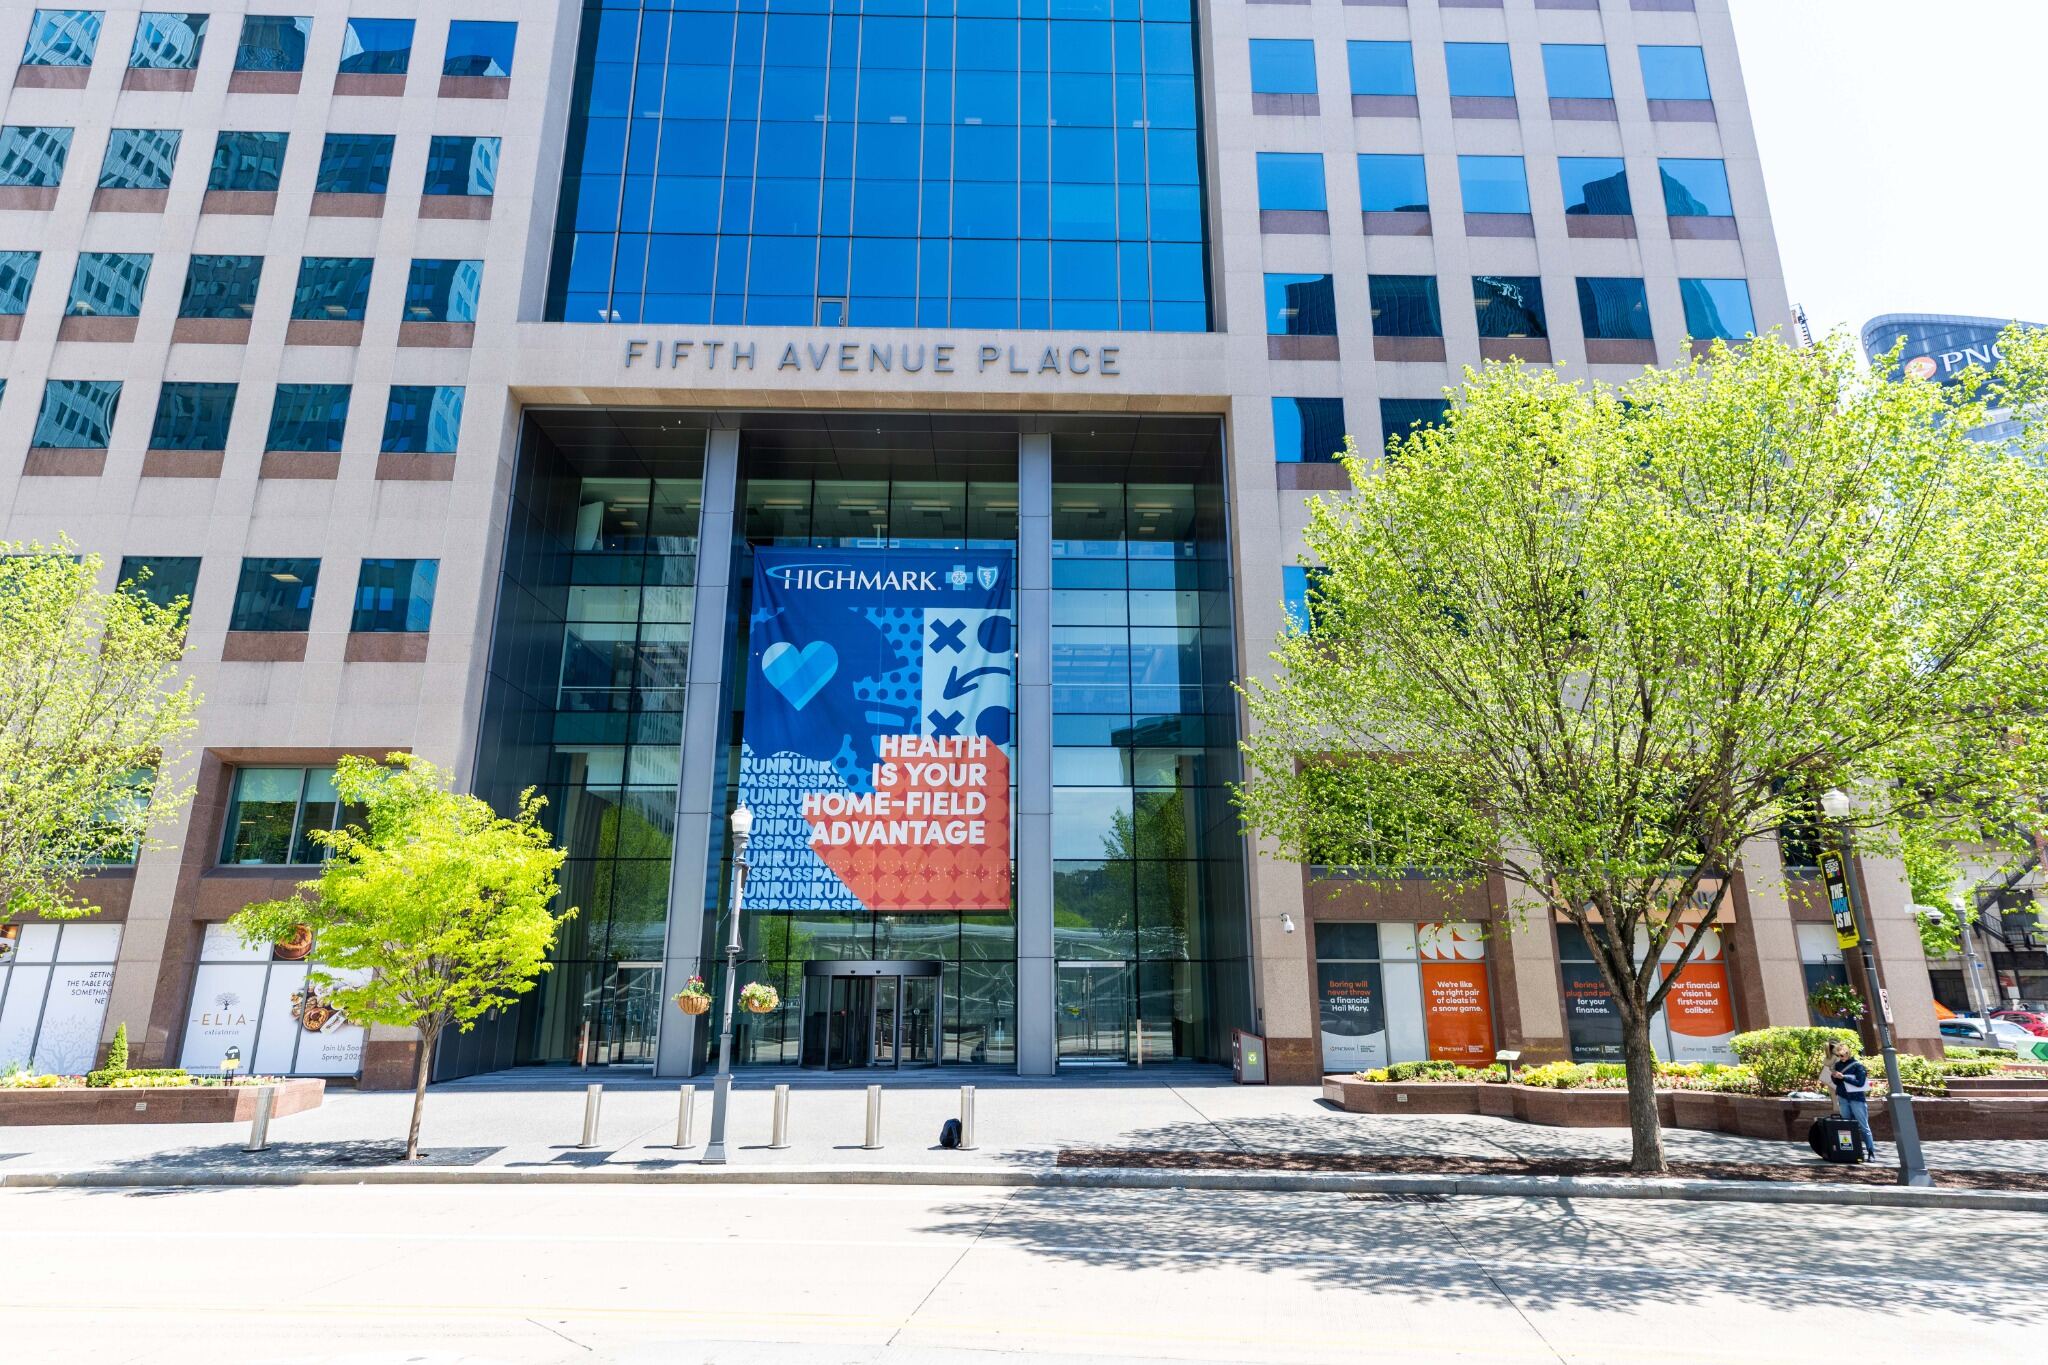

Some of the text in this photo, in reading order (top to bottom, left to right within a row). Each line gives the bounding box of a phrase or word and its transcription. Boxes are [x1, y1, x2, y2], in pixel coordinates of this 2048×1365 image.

[624, 338, 1121, 376] FIFTH AVENUE PLACE
[1938, 341, 2006, 372] PNC
[784, 569, 937, 591] HIGHMARK
[879, 734, 987, 758] HEALTH
[871, 762, 987, 787] IS YOUR
[801, 791, 987, 817] HOME-FIELD
[807, 820, 986, 845] ADVANTAGE
[1829, 883, 1844, 899] THE
[1329, 980, 1368, 989] Boring will
[1573, 981, 1598, 990] Boring
[1686, 981, 1720, 989] financial
[1446, 989, 1464, 998] right
[1465, 989, 1480, 997] pair
[1566, 990, 1582, 998] plug
[1599, 990, 1611, 998] pla
[1337, 996, 1370, 1004] financial
[1437, 996, 1477, 1004] of cleats in
[1589, 999, 1606, 1007] your
[1677, 998, 1719, 1006] first-round
[1348, 1005, 1369, 1013] Mary.
[1575, 1006, 1610, 1014] finances.
[1684, 1006, 1715, 1014] caliber.
[201, 1013, 247, 1026] ELIA
[322, 1044, 336, 1052] Join
[347, 1044, 361, 1052] Soo
[321, 1053, 343, 1062] Spring
